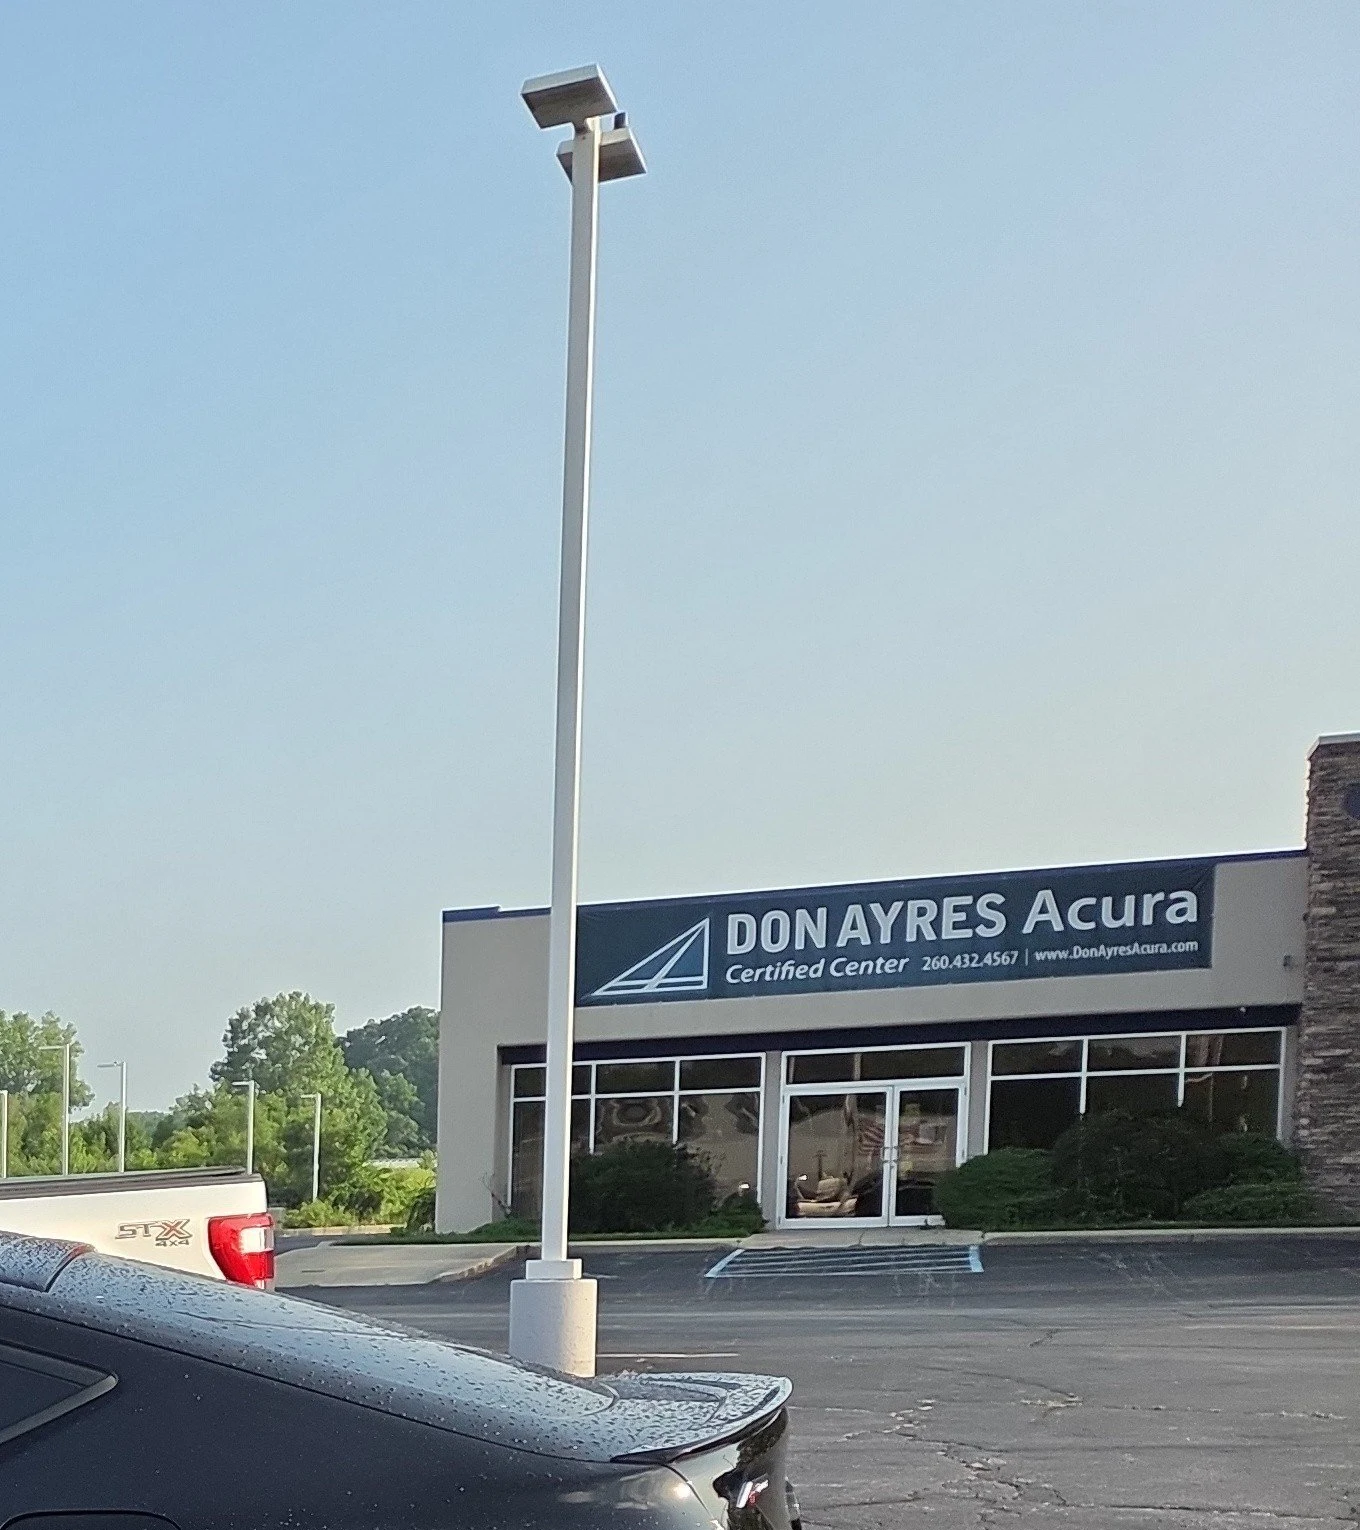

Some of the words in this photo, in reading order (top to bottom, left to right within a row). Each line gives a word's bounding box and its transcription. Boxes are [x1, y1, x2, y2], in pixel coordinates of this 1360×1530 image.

[726, 906, 828, 955] DON
[835, 892, 1007, 949] AYRES
[1022, 889, 1198, 935] Acura
[725, 957, 826, 984] Certified
[829, 956, 910, 978] Center
[921, 950, 1019, 972] 260.432.4567
[1035, 940, 1199, 961] www.DonAyresAcura.com
[114, 1218, 193, 1241] STX
